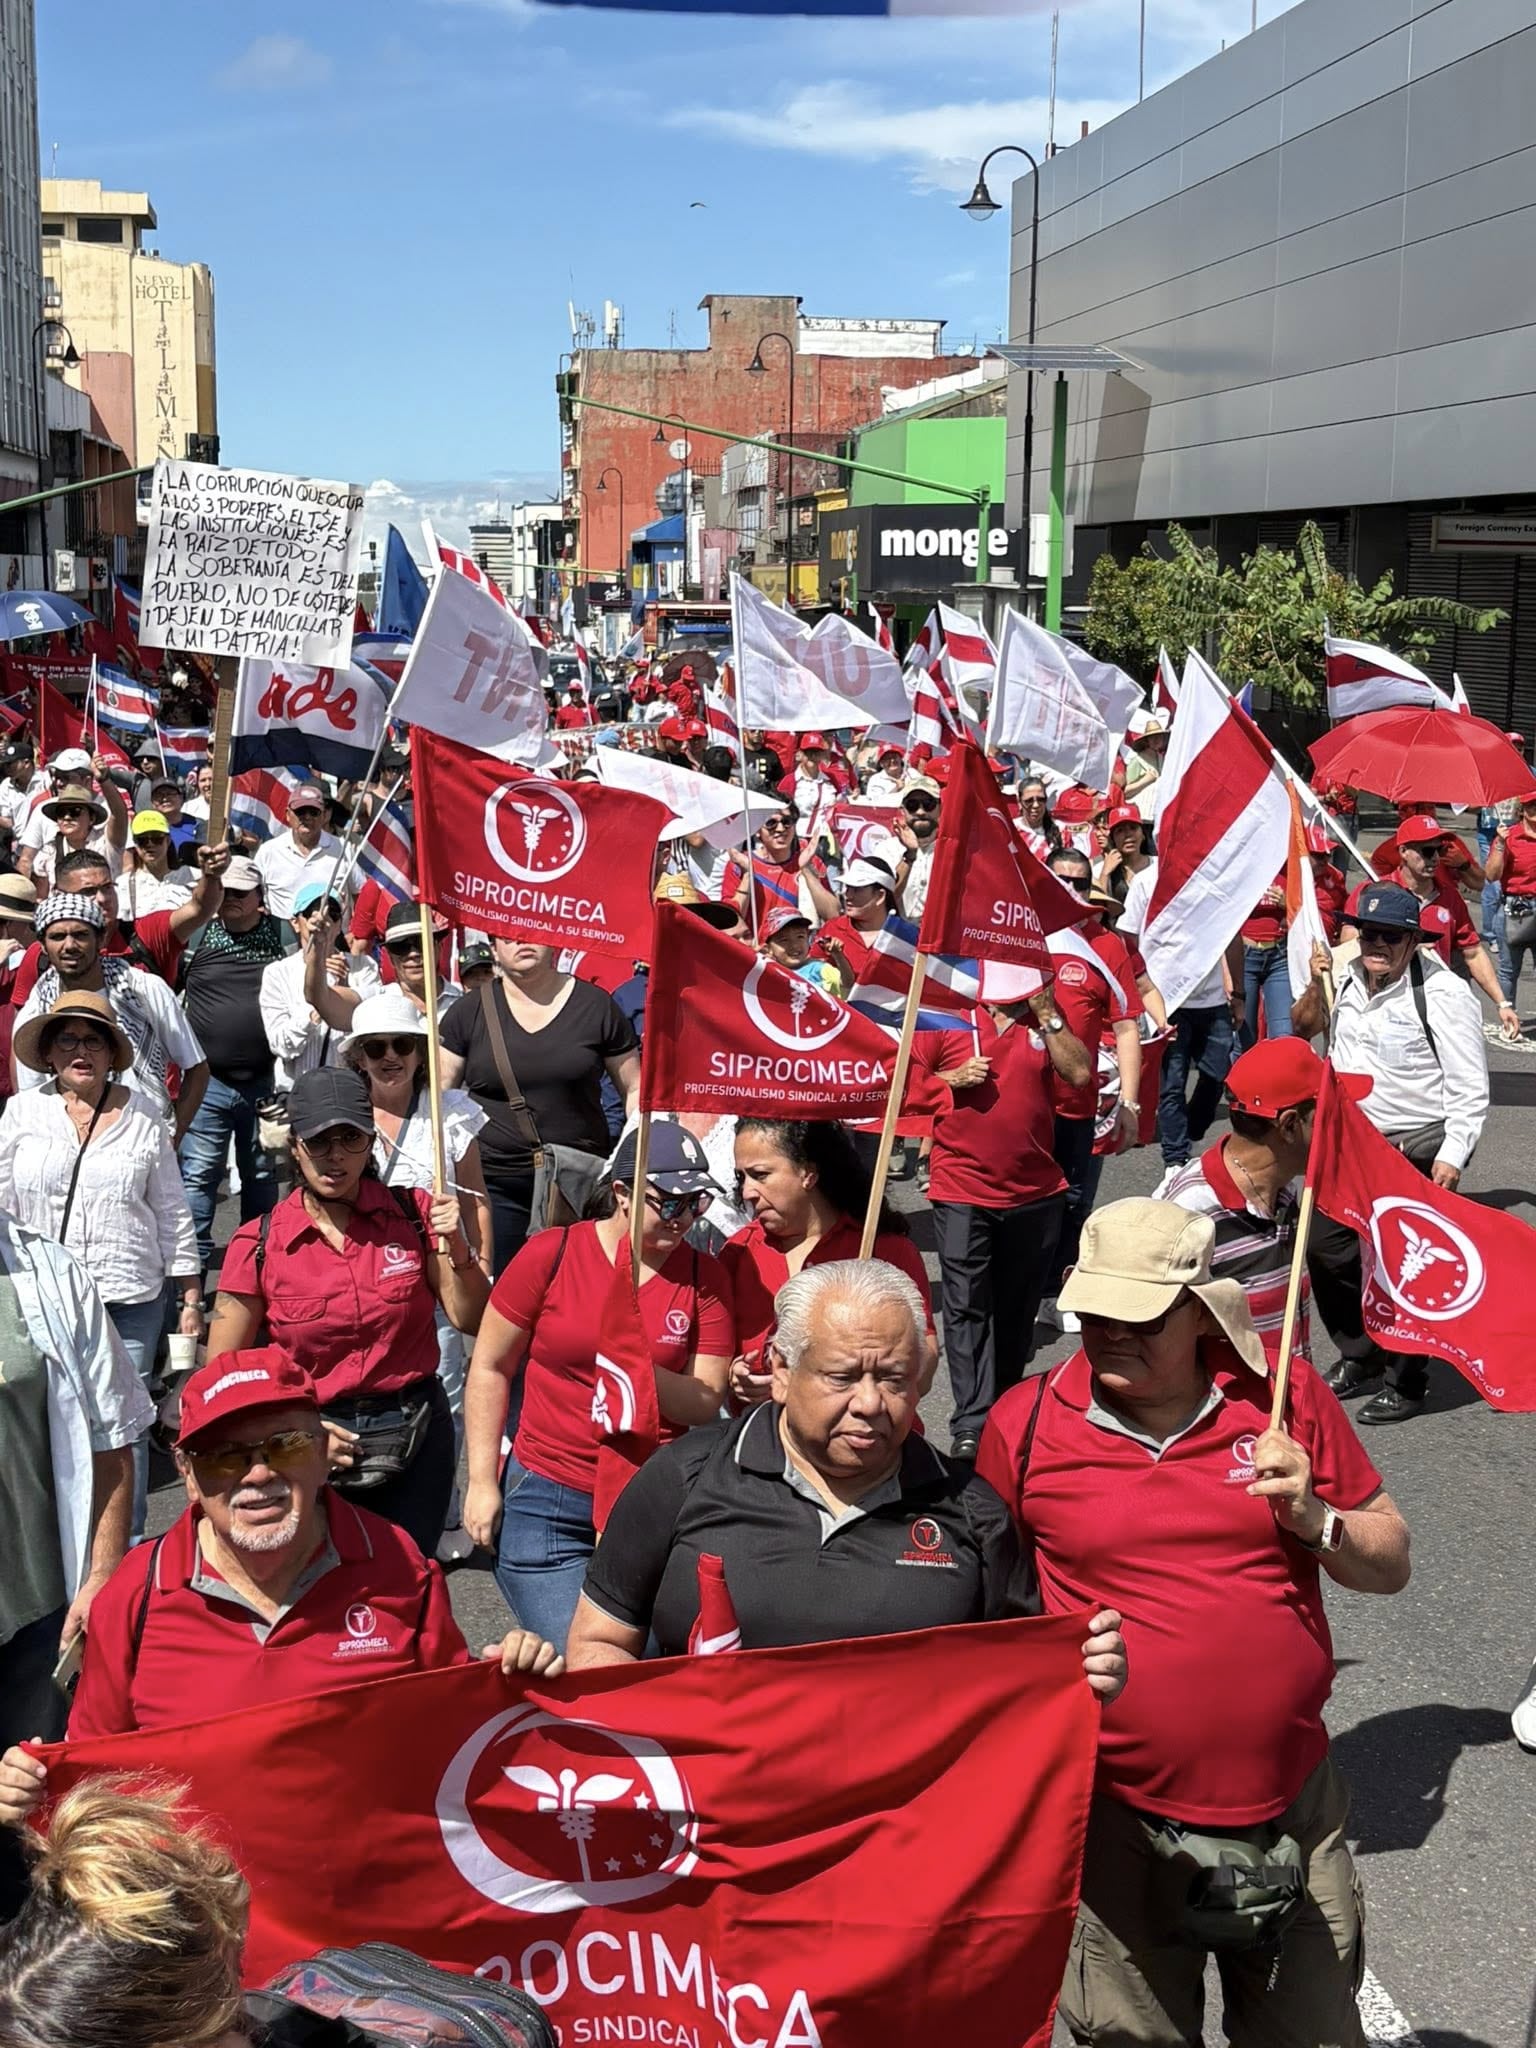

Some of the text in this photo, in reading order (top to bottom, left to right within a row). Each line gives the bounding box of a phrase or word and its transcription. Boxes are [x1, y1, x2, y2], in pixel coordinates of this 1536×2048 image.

[136, 276, 174, 285] NUEVO
[136, 285, 191, 299] HOTEL
[196, 474, 293, 499] CORRUPCIÓN
[296, 484, 325, 505] QUE
[204, 497, 214, 513] 3
[289, 509, 305, 527] EL
[159, 530, 177, 549] LA
[184, 532, 229, 553] RAÍZ
[232, 537, 259, 556] DE
[160, 510, 190, 530] LAS
[323, 535, 347, 552] ES
[1455, 523, 1486, 533] Foreign
[1487, 523, 1523, 534] Currency
[880, 527, 1009, 567] monge
[155, 552, 354, 590] LA SOBERANÍA ES DEL
[151, 581, 231, 607] PUEBLO,
[236, 584, 268, 606] NO
[273, 587, 301, 607] DE
[220, 608, 249, 627] DE
[250, 609, 343, 638] MANCILLAR
[165, 627, 299, 658] A MI PATRIA!
[454, 872, 606, 924] SIPROCIMECA
[511, 915, 555, 932] SINDICAL
[556, 924, 564, 933] A
[566, 926, 579, 936] SU
[581, 928, 625, 944] SERVICIO
[710, 1051, 888, 1085] SIPROCIMECA
[684, 1082, 785, 1100] PROFESIONALISMO
[787, 1090, 837, 1102] SINDICAL
[839, 1092, 847, 1102] A
[849, 1092, 863, 1102] SU
